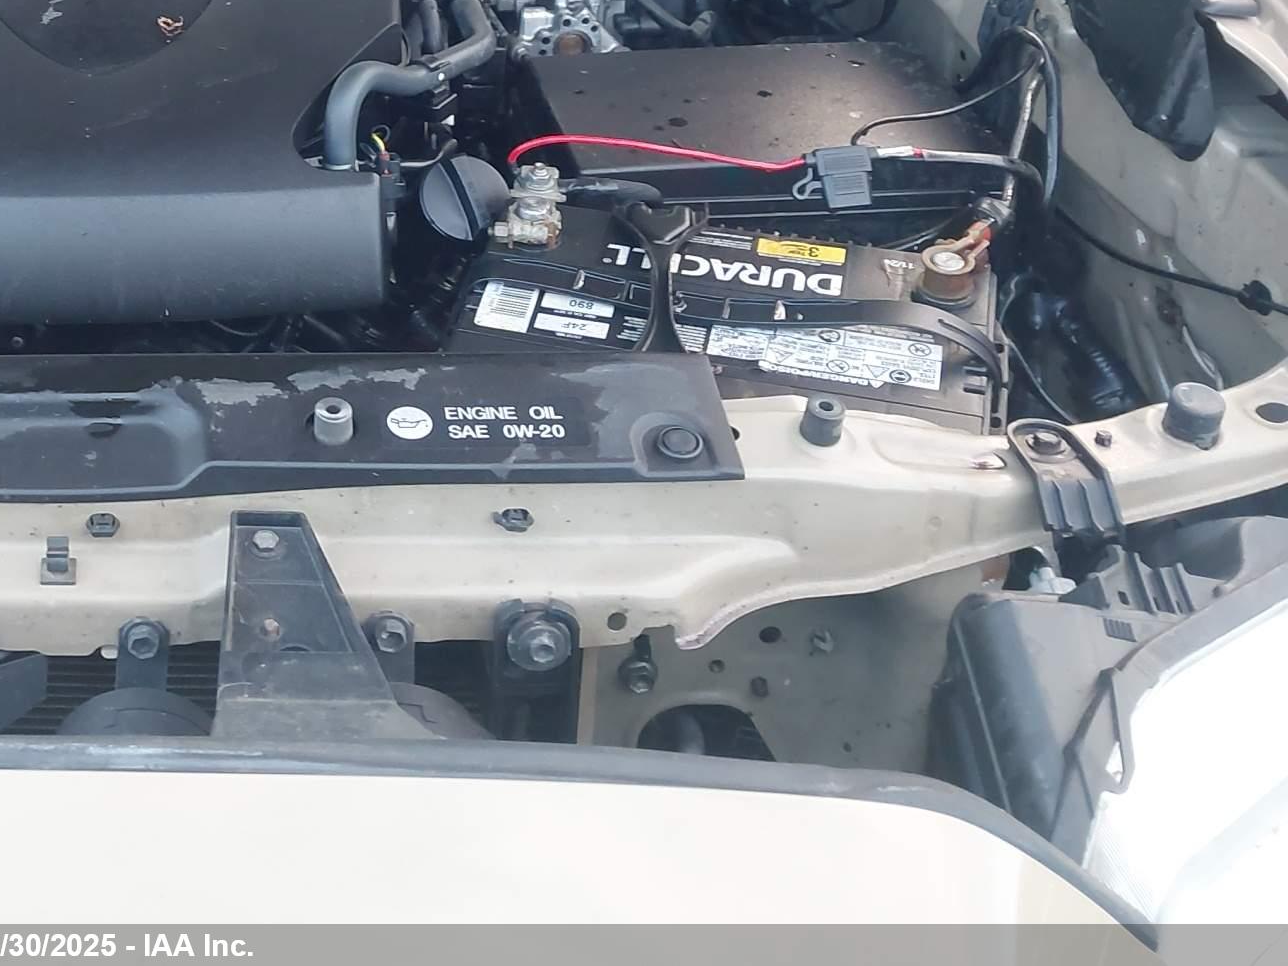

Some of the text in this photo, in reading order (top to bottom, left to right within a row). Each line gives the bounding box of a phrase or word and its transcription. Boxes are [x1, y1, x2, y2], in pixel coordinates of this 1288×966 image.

[808, 246, 820, 258] 3
[568, 299, 594, 311] 890
[561, 322, 587, 332] 24F
[444, 406, 563, 419] ENGINE OIL
[448, 425, 565, 439] SAE 0W-20
